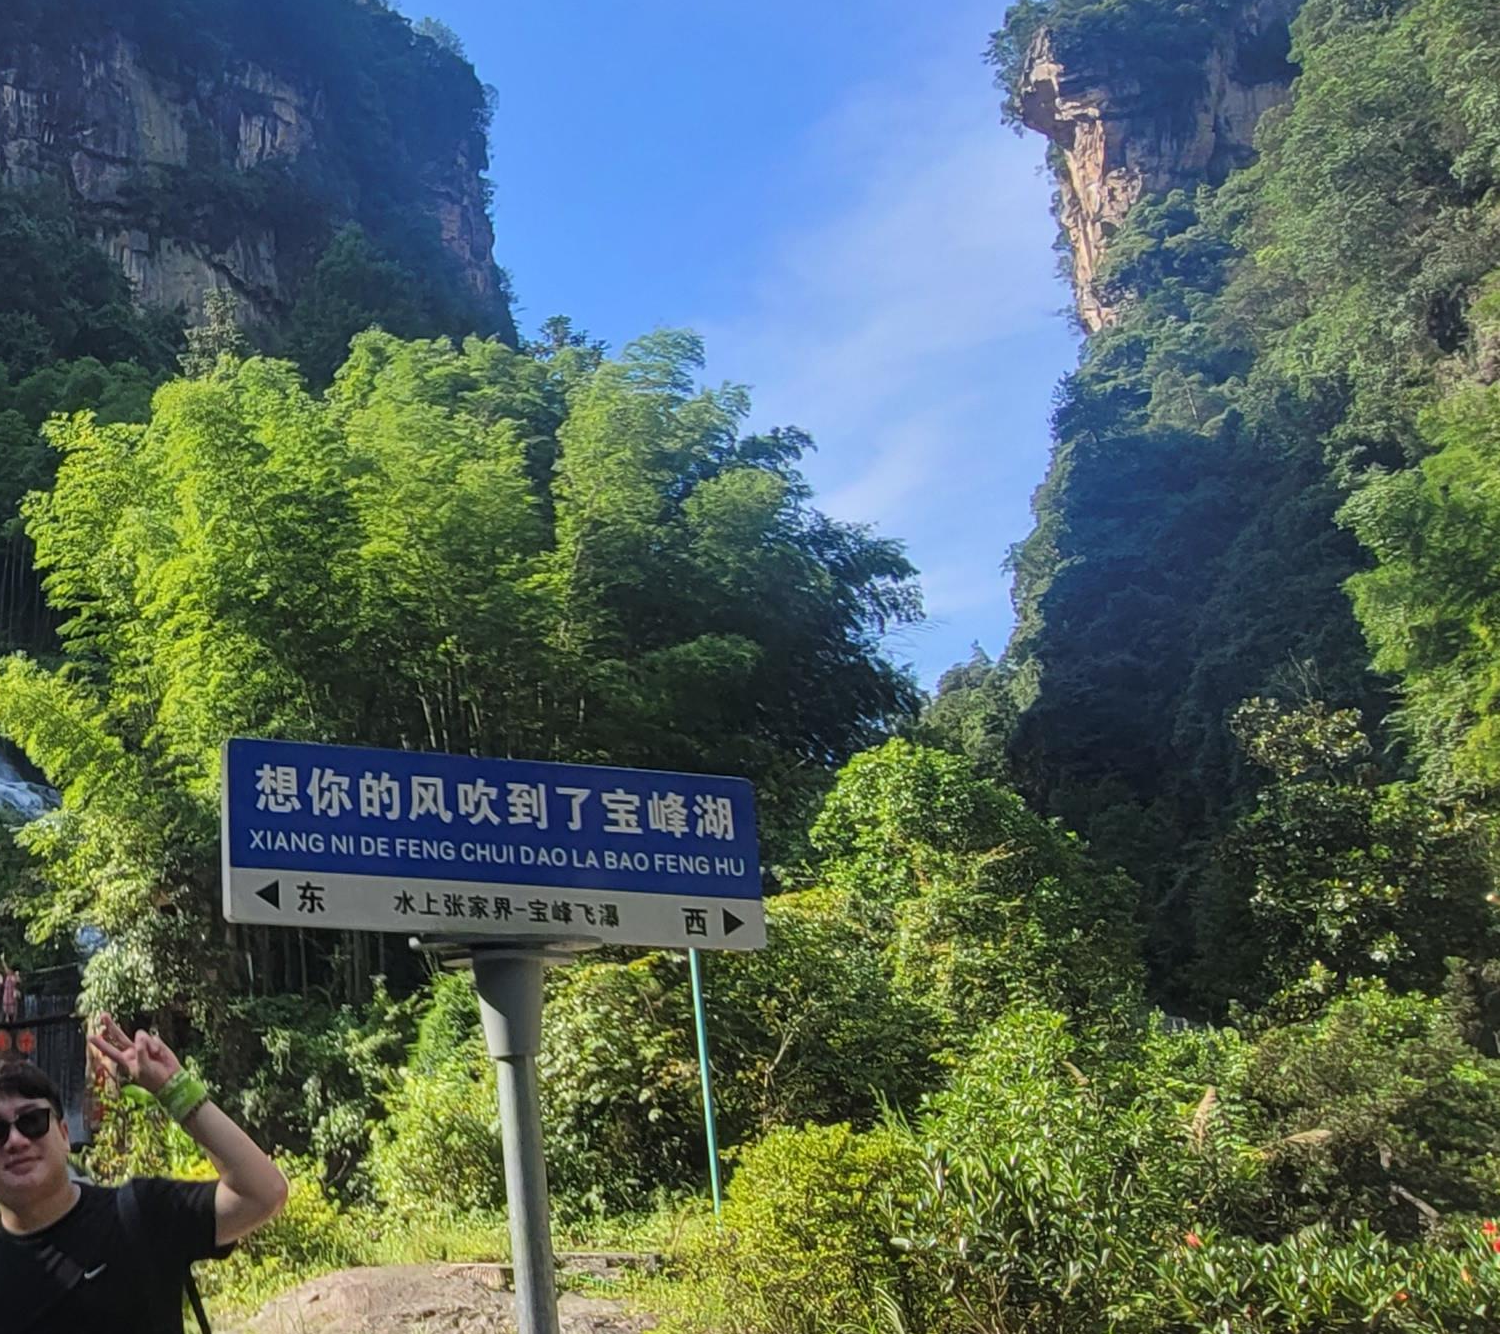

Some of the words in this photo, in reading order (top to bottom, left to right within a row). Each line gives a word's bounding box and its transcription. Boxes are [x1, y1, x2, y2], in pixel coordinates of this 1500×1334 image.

[255, 764, 735, 841] 想你的风吹到了宝峰湖
[250, 829, 325, 853] XIANG
[331, 835, 354, 855] NI
[361, 836, 390, 857] DE
[396, 838, 455, 862] FENG
[461, 843, 514, 865] CHUI
[520, 845, 567, 867] DAO
[573, 849, 600, 868] LA
[604, 851, 649, 872] BAO
[654, 854, 710, 875] FENG
[715, 857, 745, 877] HU
[297, 881, 325, 914] 东
[681, 907, 708, 937] 西
